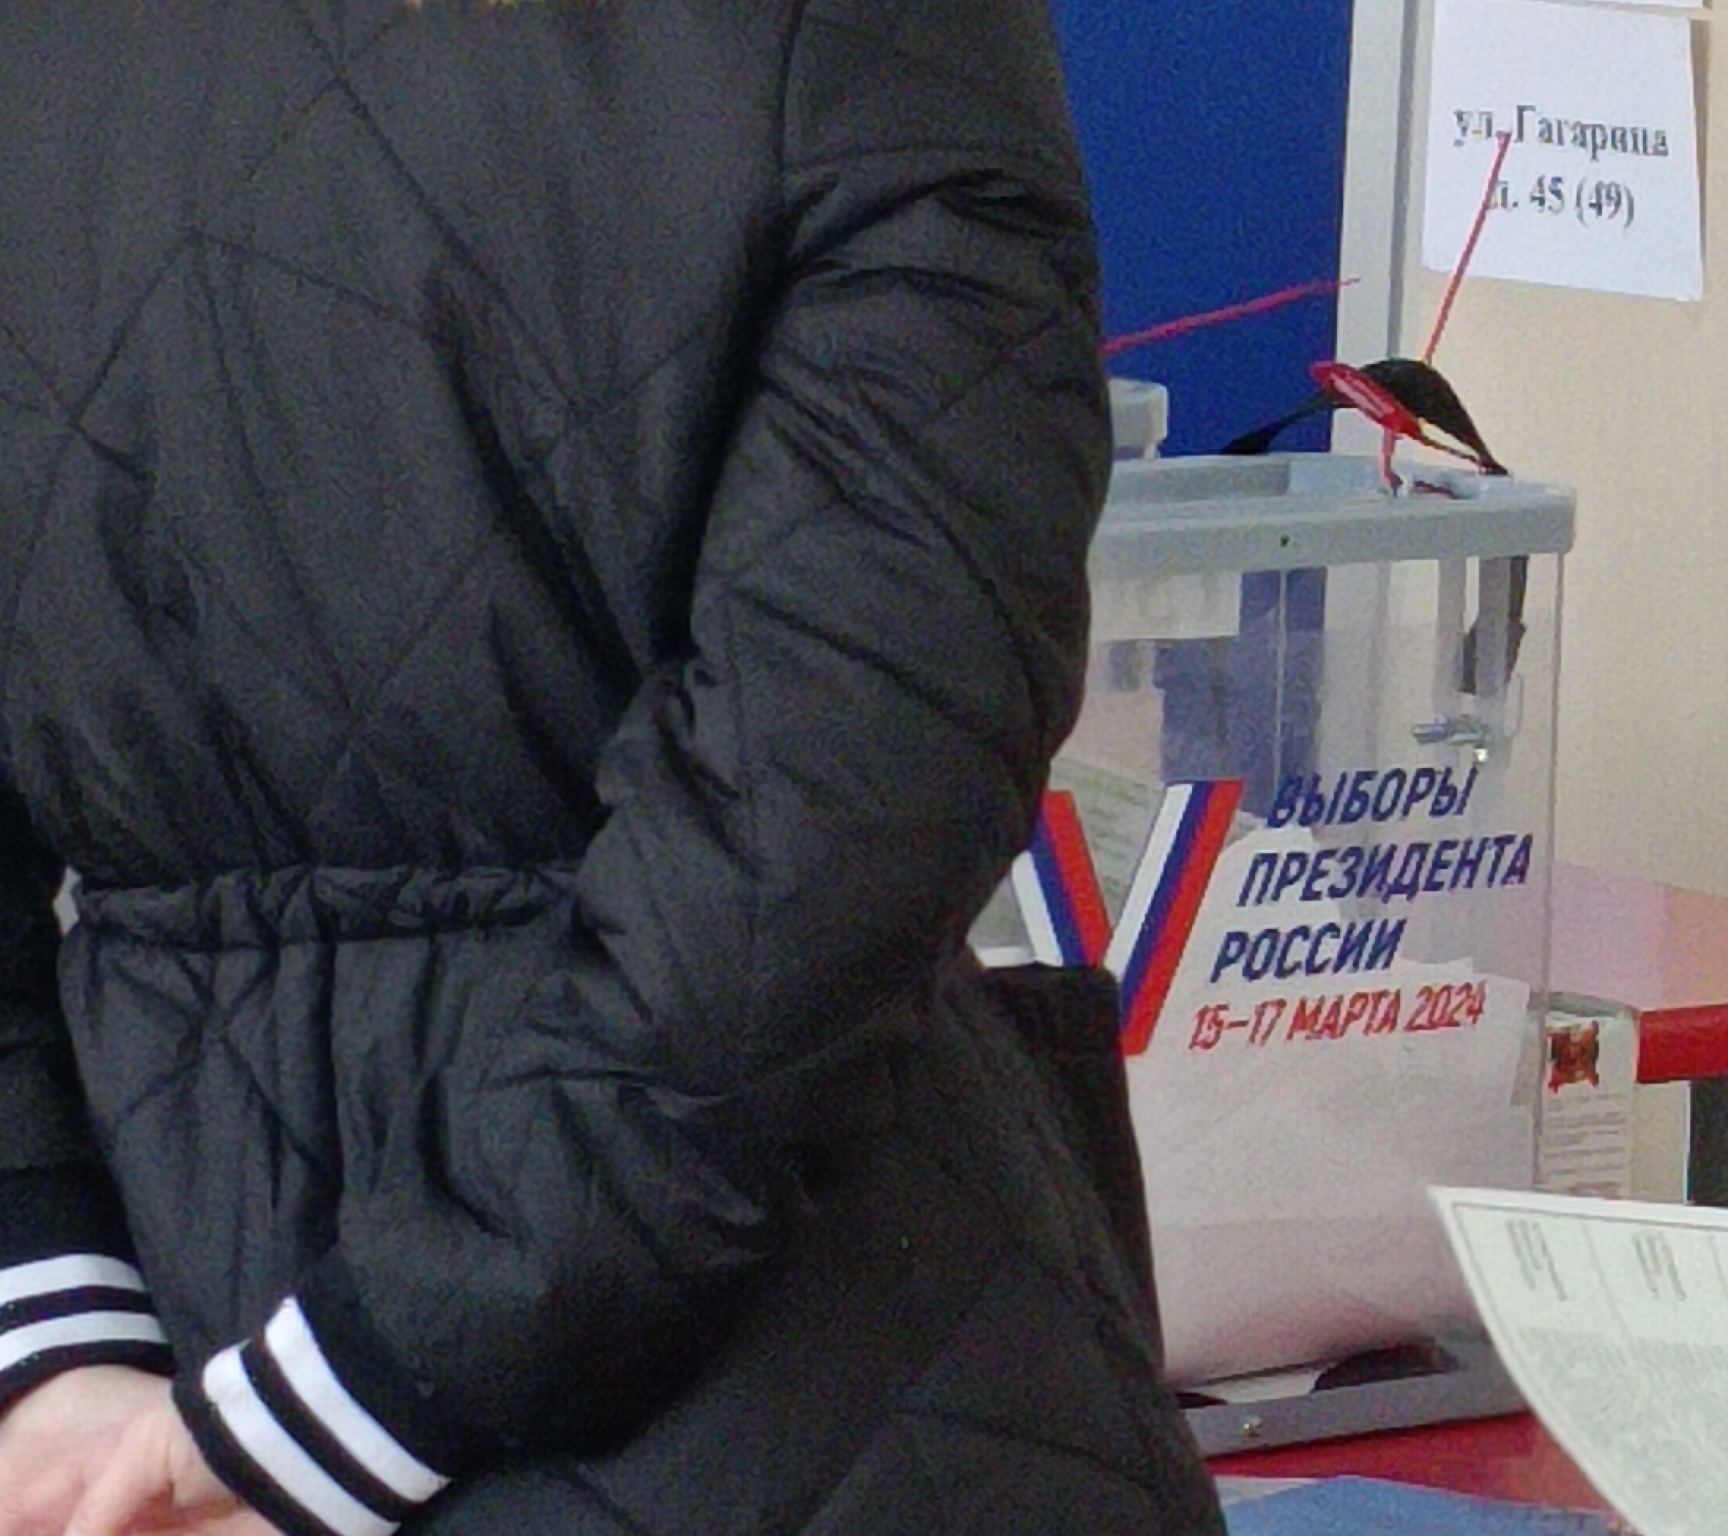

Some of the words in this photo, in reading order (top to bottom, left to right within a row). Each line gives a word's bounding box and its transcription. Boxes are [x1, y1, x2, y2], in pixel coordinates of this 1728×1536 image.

[1514, 104, 1671, 162] Гагарина
[1529, 174, 1565, 214] 45
[1575, 176, 1635, 229] (49)
[1266, 764, 1480, 830] ВЫБОРЫ
[1235, 832, 1534, 909] ПРЕЗИДЕНТА
[1209, 918, 1408, 984] РОССИИ
[1286, 988, 1401, 1041] МАРТА
[1403, 980, 1486, 1032] 2024
